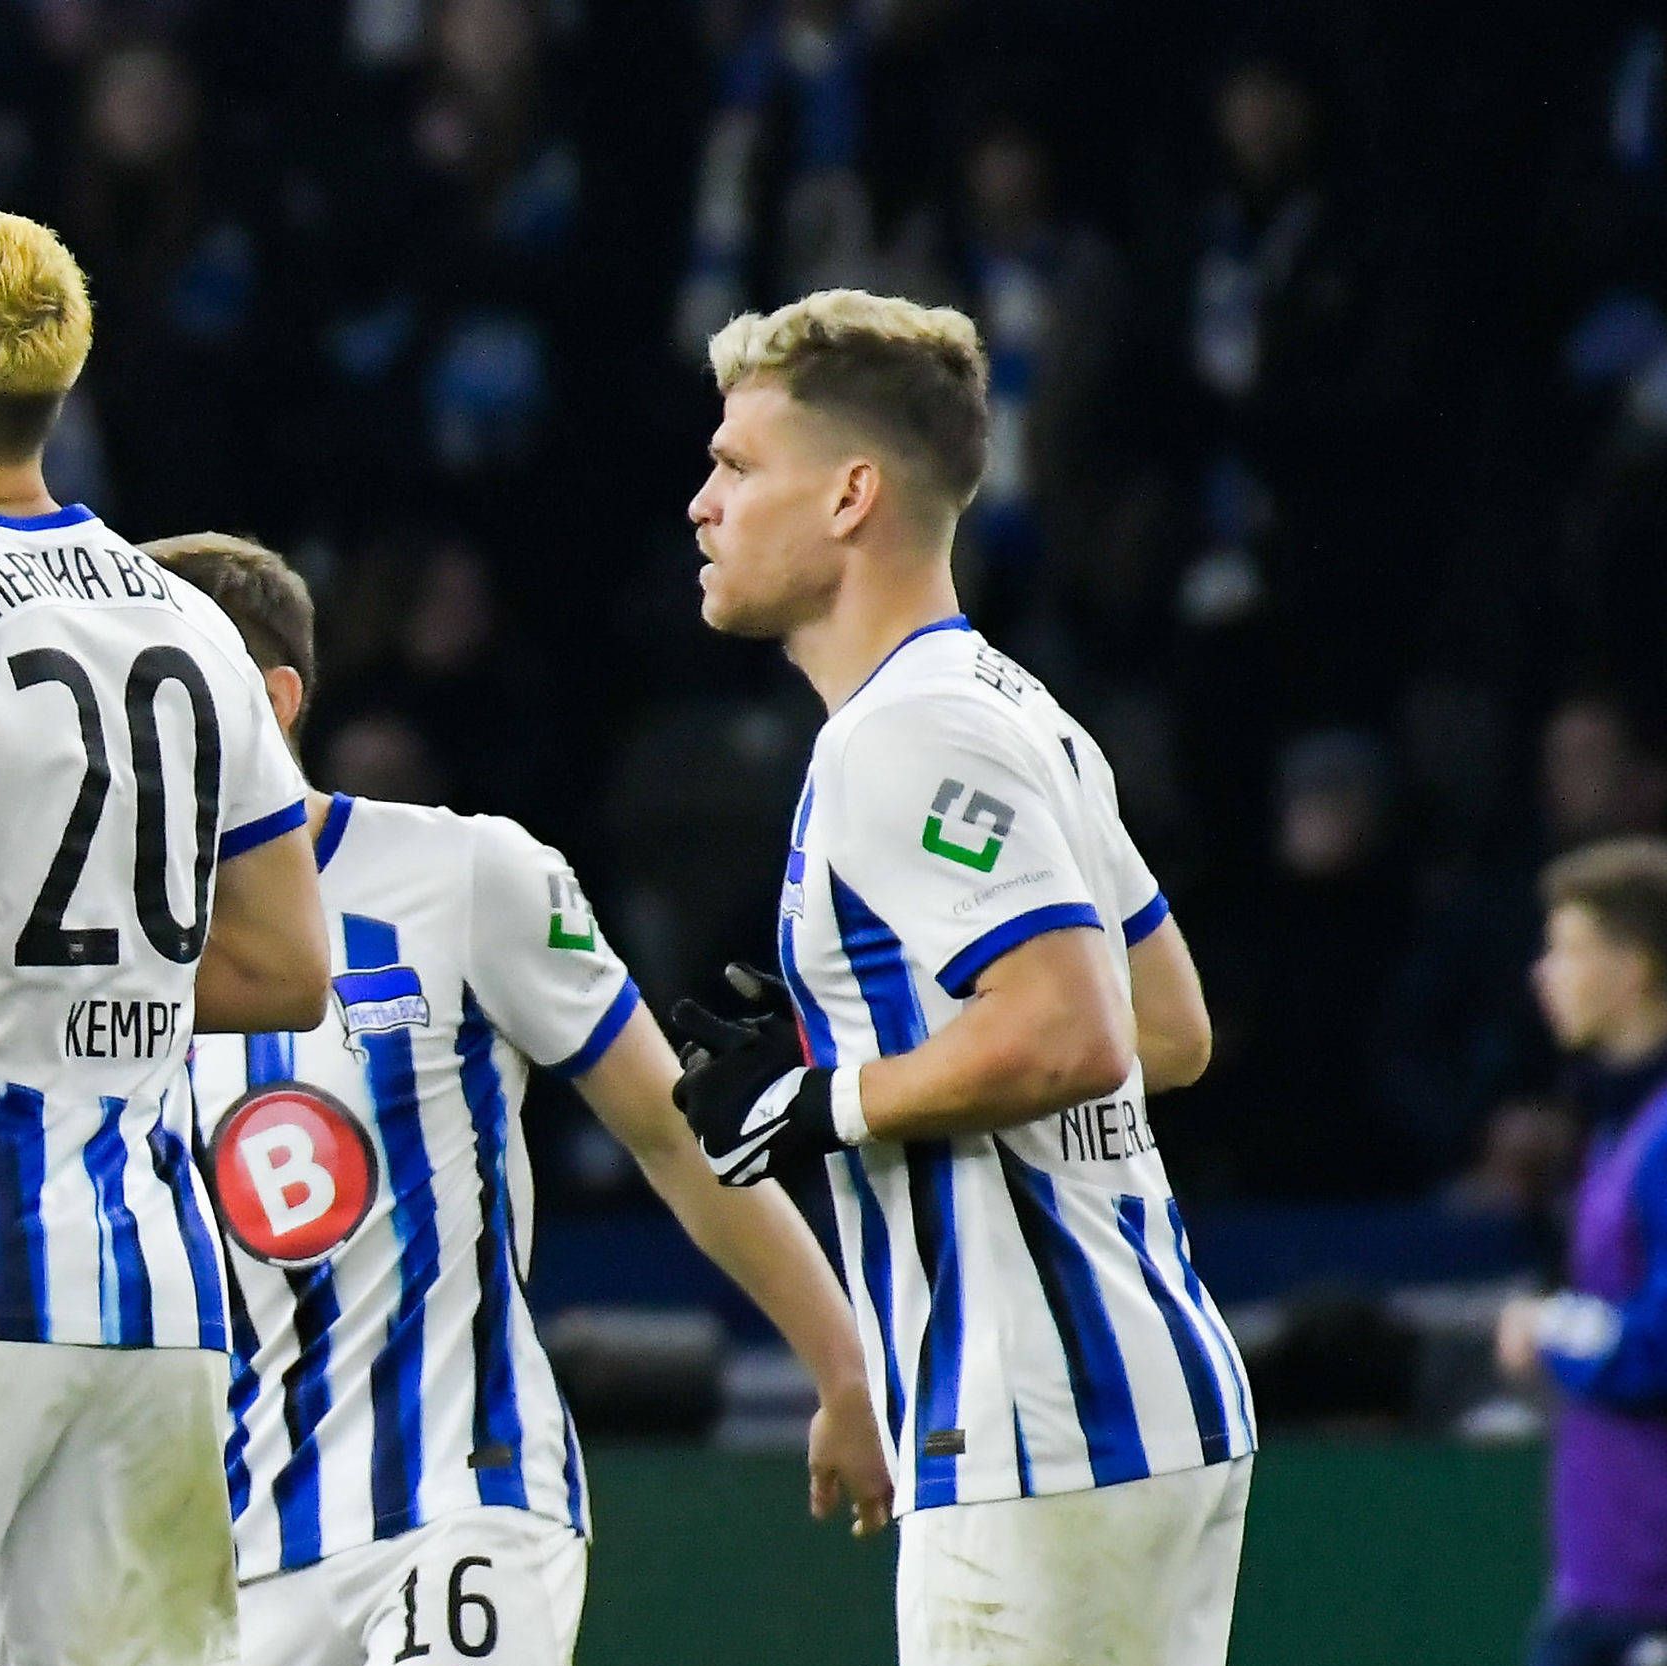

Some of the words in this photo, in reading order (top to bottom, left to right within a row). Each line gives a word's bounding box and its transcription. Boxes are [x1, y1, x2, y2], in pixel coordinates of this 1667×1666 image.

[7, 645, 222, 966] 20
[240, 1123, 336, 1238] B
[393, 1555, 498, 1664] 16
